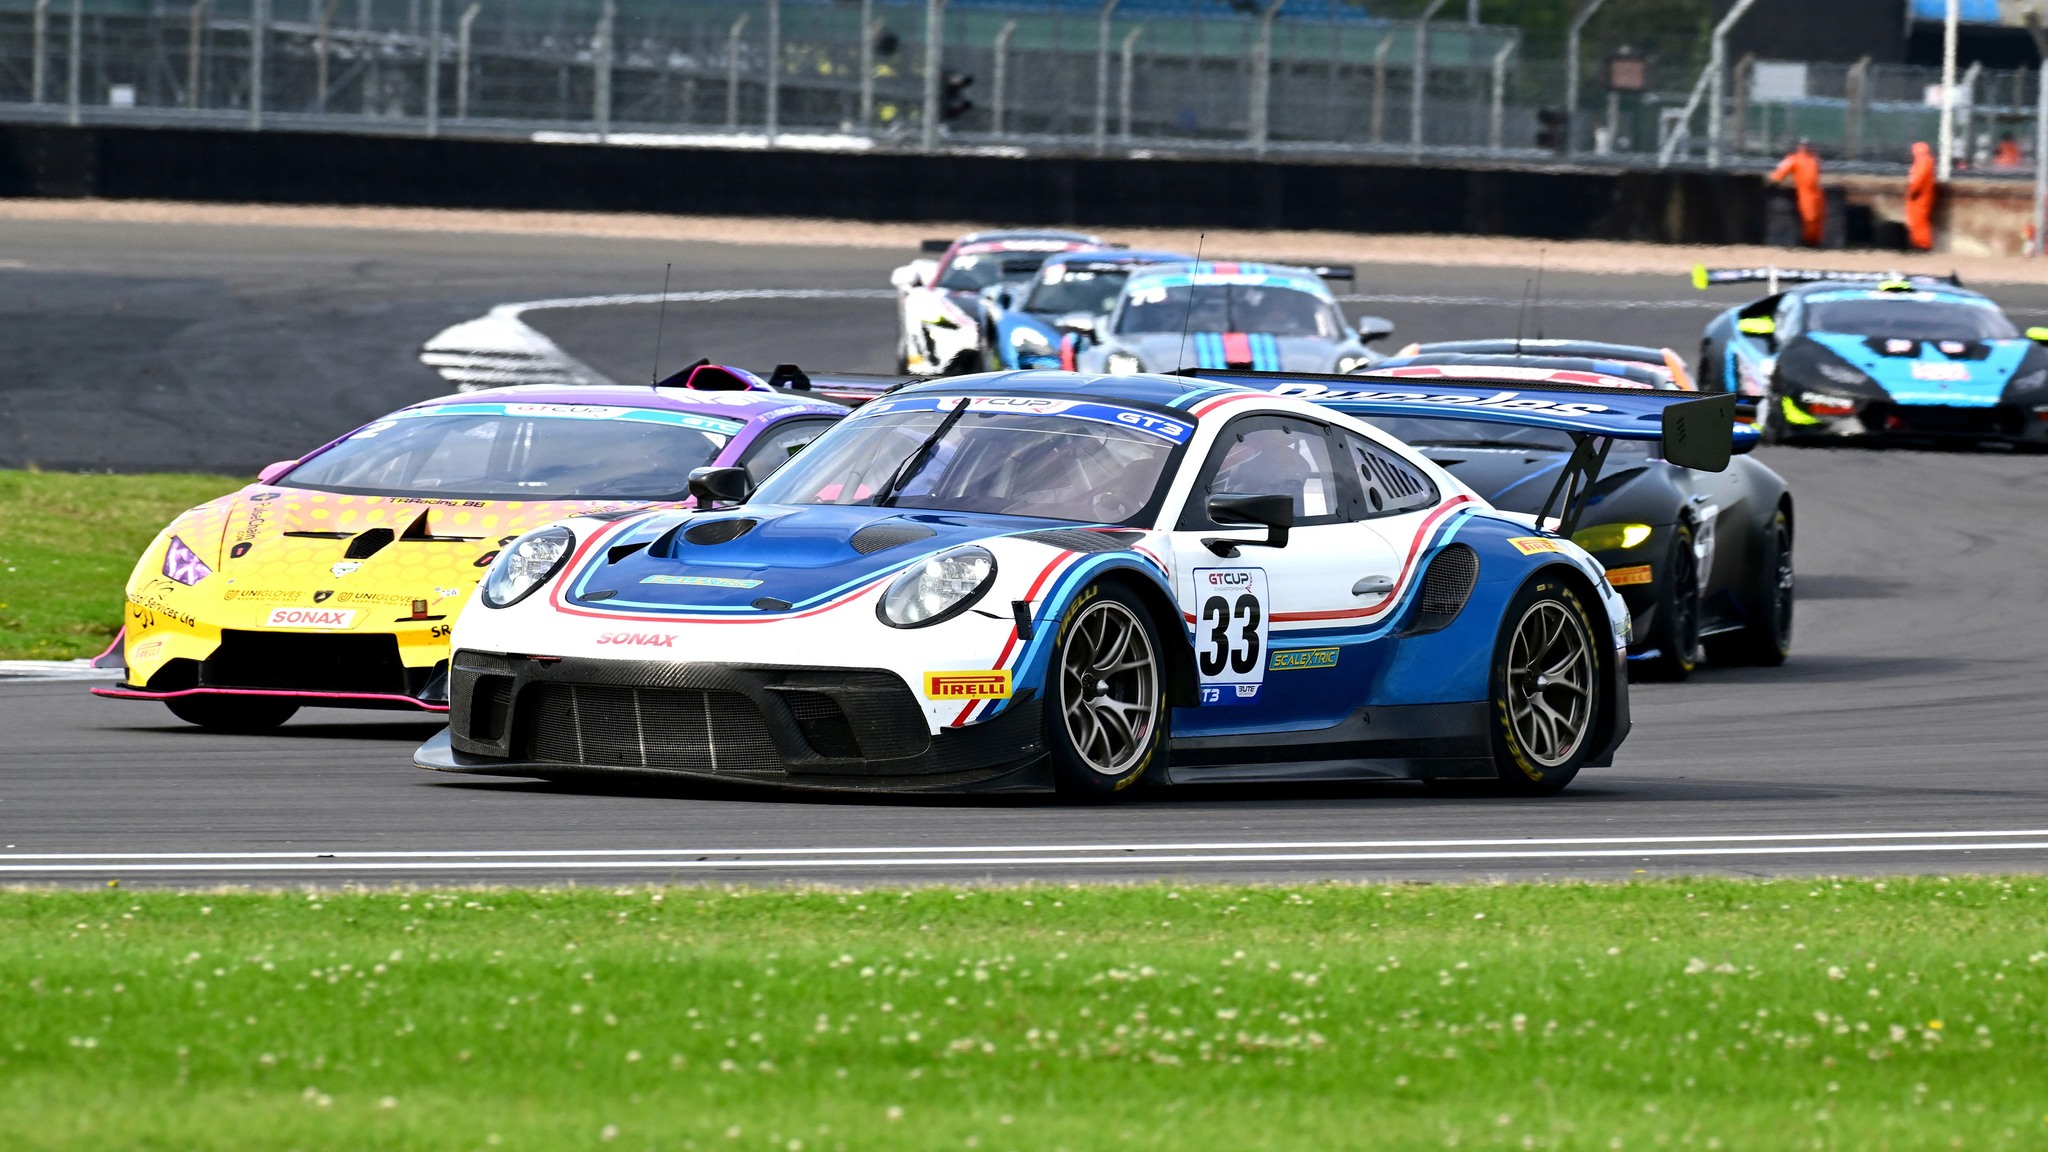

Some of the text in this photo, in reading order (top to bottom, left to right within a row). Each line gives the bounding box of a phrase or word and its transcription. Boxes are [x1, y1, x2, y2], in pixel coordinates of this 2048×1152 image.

[1116, 411, 1188, 437] GT3
[1209, 573, 1249, 584] GTCUP
[241, 590, 302, 598] UNIGLOVES
[145, 597, 179, 619] Services
[180, 612, 196, 627] Ltd
[272, 610, 346, 624] SONAX
[596, 632, 680, 647] SONAX
[1200, 593, 1261, 676] 33
[1273, 650, 1336, 668] SCALEXTRIC
[932, 676, 1006, 695] PIRELLI
[1201, 688, 1220, 703] T3
